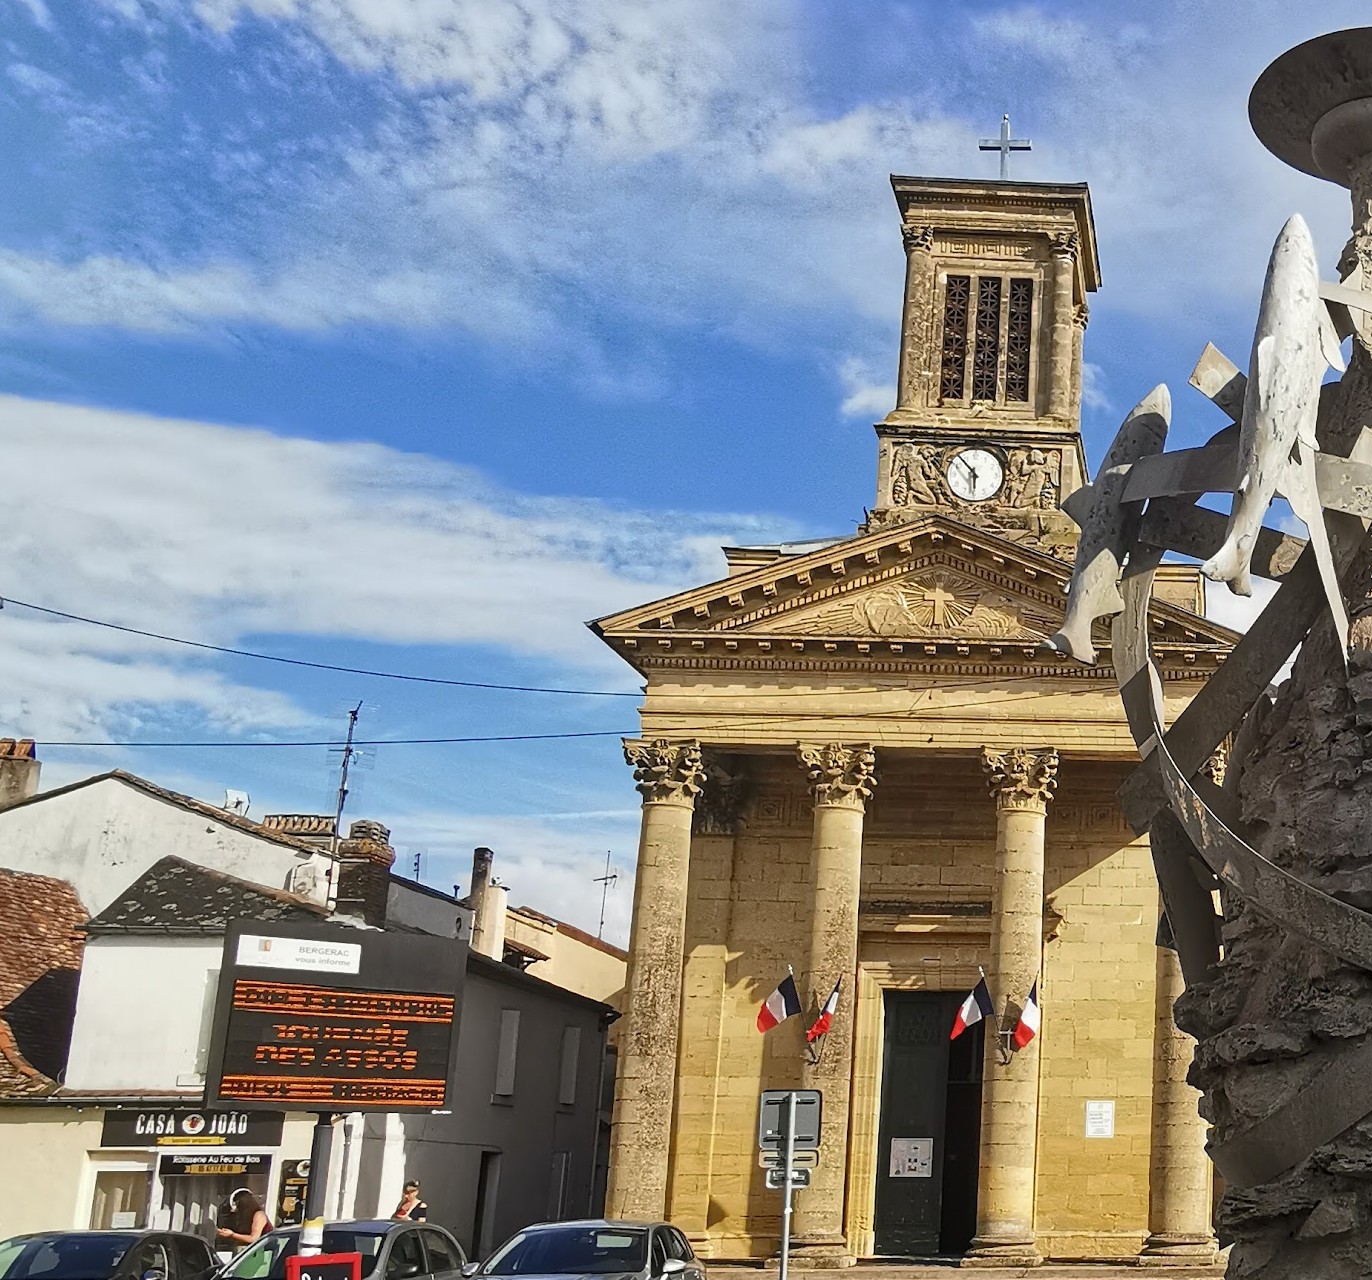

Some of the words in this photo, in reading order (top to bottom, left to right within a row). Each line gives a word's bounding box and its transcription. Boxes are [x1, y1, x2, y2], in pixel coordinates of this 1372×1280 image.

[298, 946, 350, 957] BERGERAC
[295, 956, 316, 965] vous
[318, 957, 351, 967] informe
[135, 1114, 175, 1135] CASA
[209, 1111, 248, 1135] JOÃO
